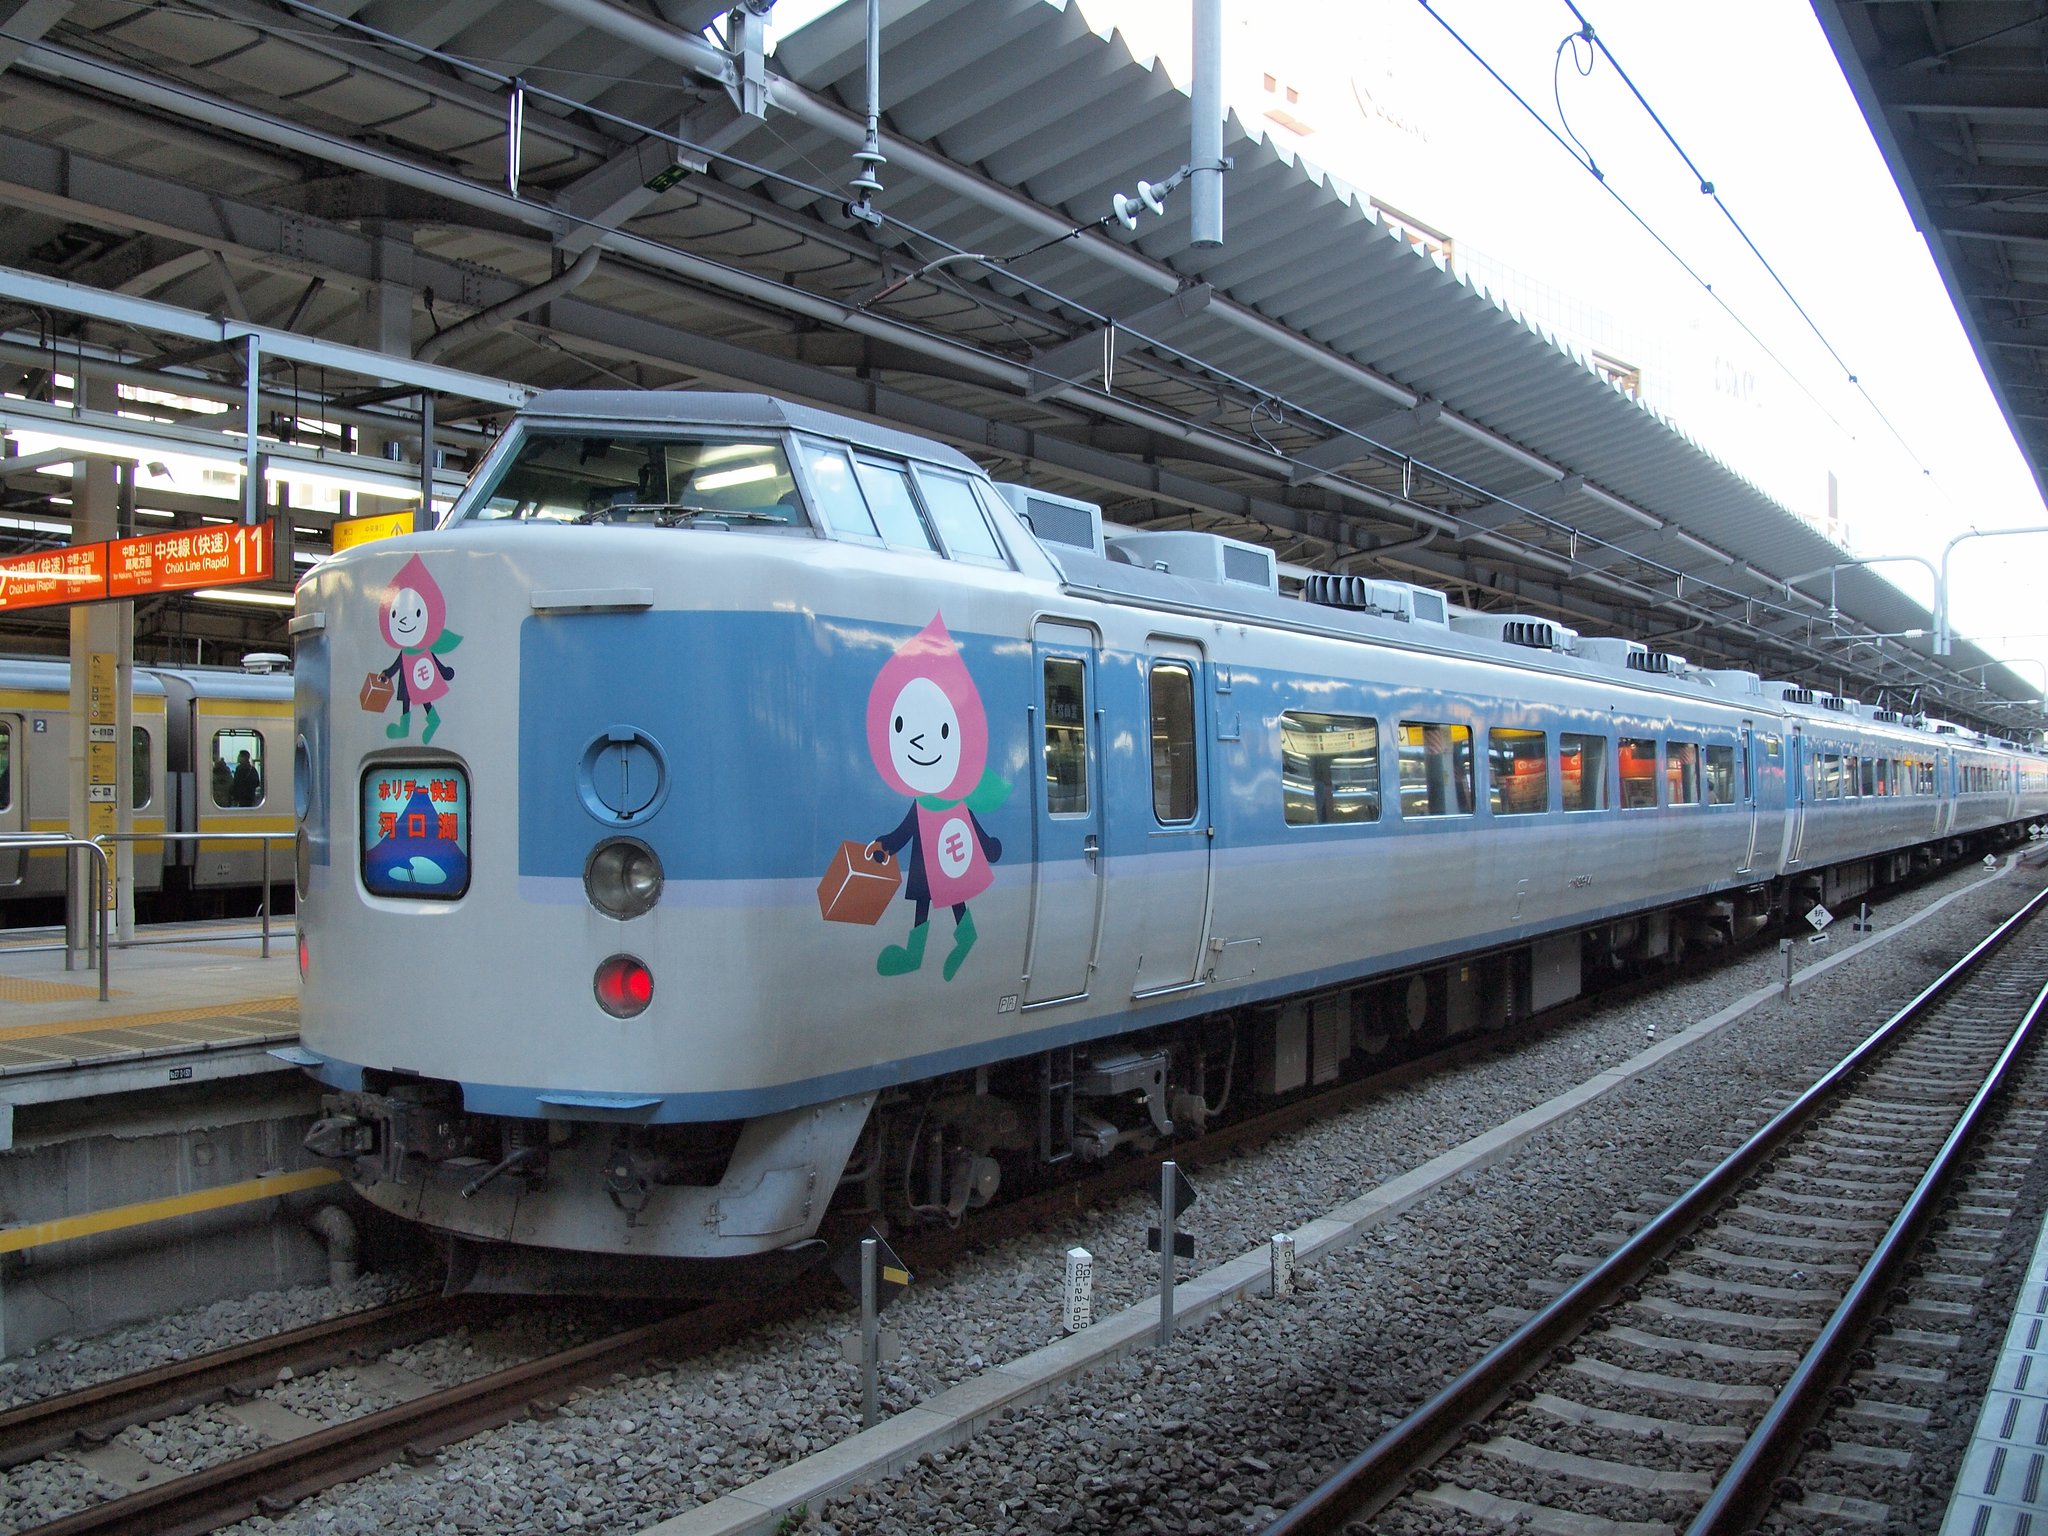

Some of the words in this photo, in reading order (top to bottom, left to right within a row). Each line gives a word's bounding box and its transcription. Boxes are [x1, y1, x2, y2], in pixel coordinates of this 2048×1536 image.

[154, 531, 230, 560] 中央線（快速）
[234, 526, 263, 576] 11
[185, 560, 201, 573] Line
[202, 554, 230, 572] (Rapid)
[24, 582, 36, 593] Line
[36, 579, 57, 593] (Rapid)
[417, 664, 430, 682] モ
[36, 720, 45, 731] 2
[378, 778, 458, 802] ホリデー快速
[378, 811, 458, 841] 河口湖
[945, 832, 965, 863] モ
[1814, 918, 1823, 927] 4
[1072, 1263, 1084, 1330] CCL=22.900
[1080, 1295, 1090, 1329] 7.110
